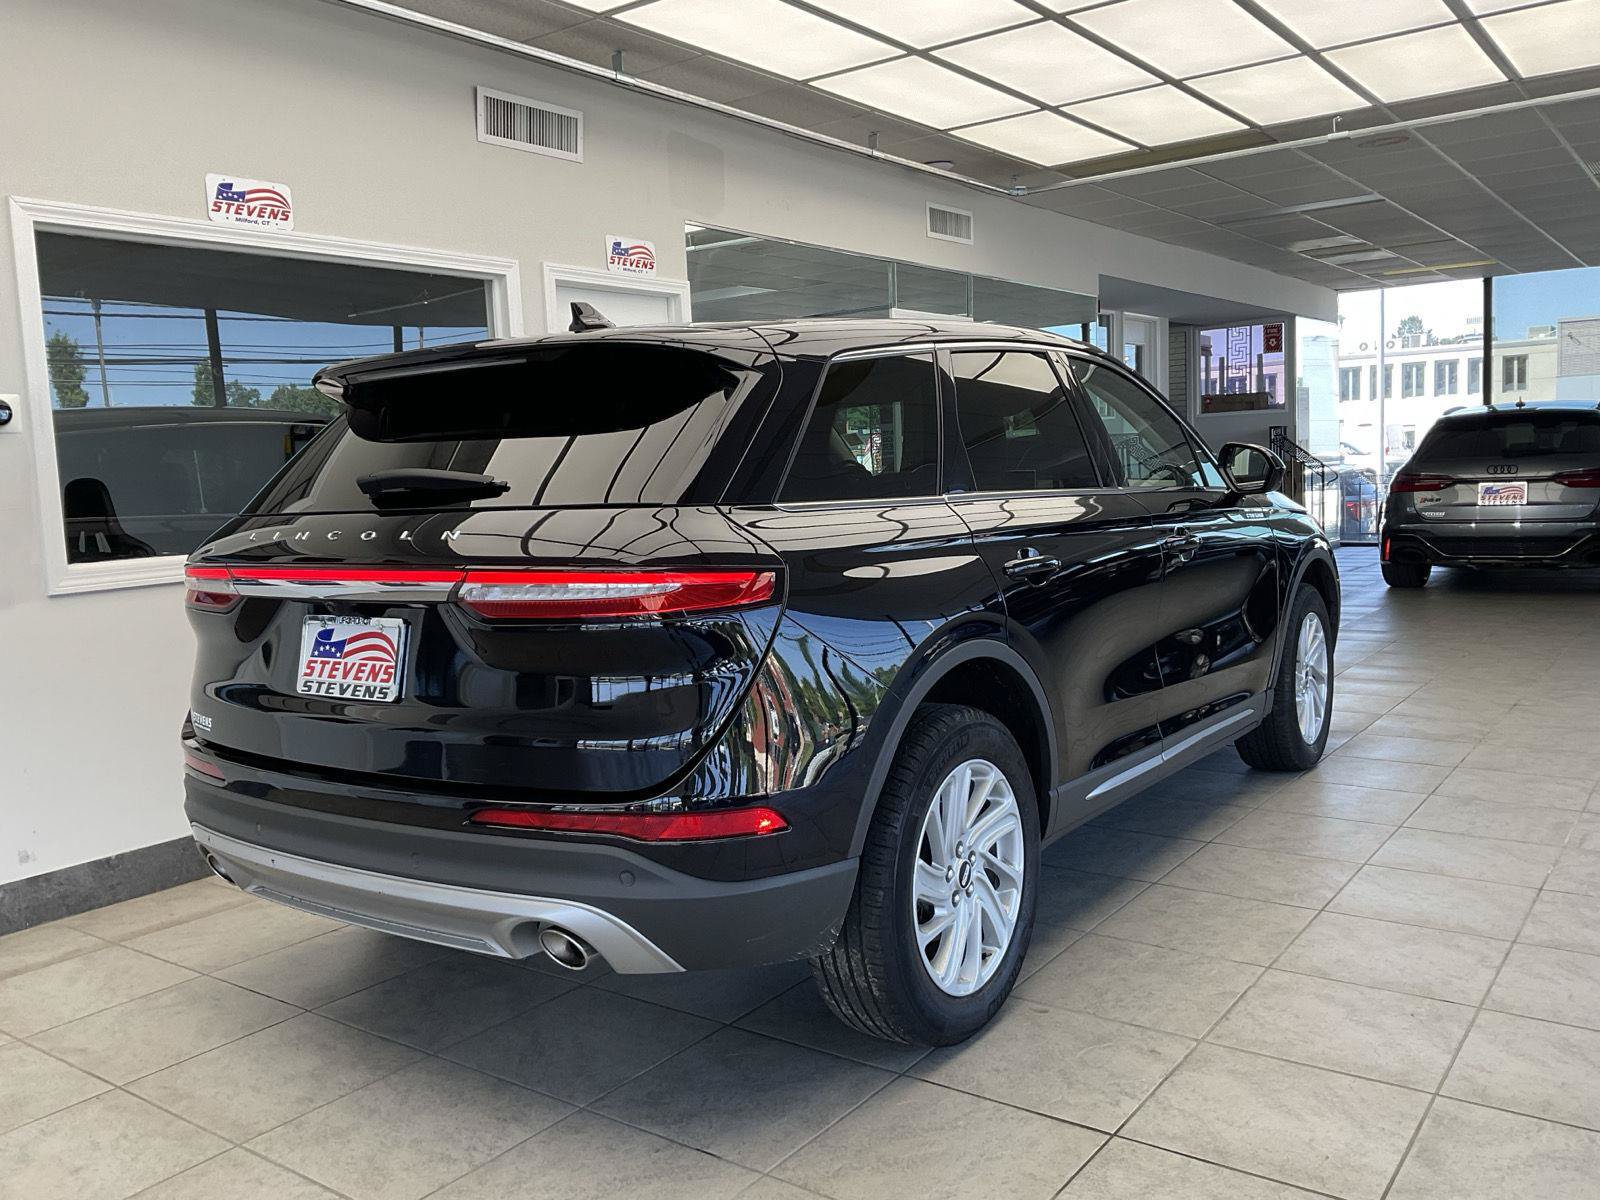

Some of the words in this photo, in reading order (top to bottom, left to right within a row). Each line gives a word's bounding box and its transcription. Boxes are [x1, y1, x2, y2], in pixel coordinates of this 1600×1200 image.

[211, 200, 291, 221] STEVENS
[235, 217, 259, 225] Milford,
[609, 255, 655, 270] STEVENS
[249, 530, 461, 541] LINCOLN
[303, 659, 395, 684] STEVENS
[301, 680, 390, 700] STEVENS
